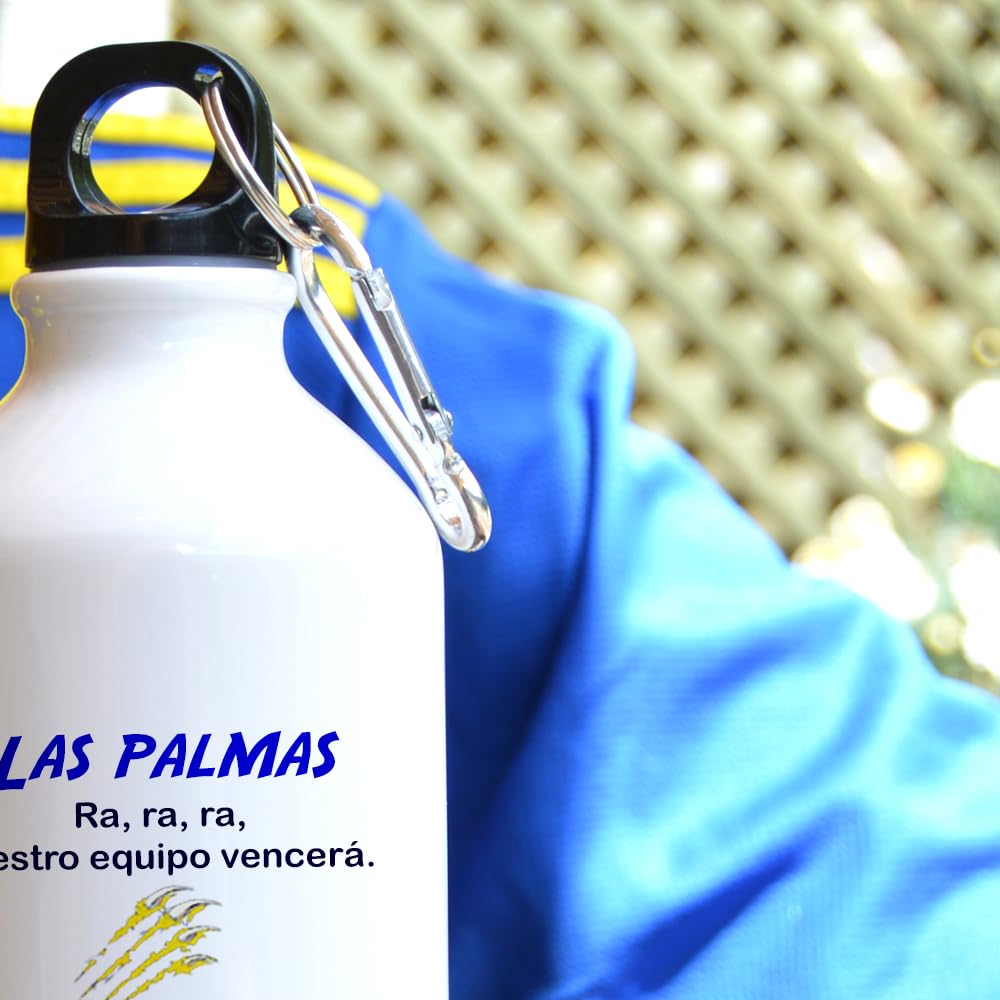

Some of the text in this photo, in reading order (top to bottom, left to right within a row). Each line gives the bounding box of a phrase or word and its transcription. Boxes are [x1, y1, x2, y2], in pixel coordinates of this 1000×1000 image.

[114, 731, 340, 780] PALMAS
[74, 802, 247, 833] Ra, ra, ra,
[89, 843, 211, 876] equipo
[221, 840, 375, 870] vencerá.
